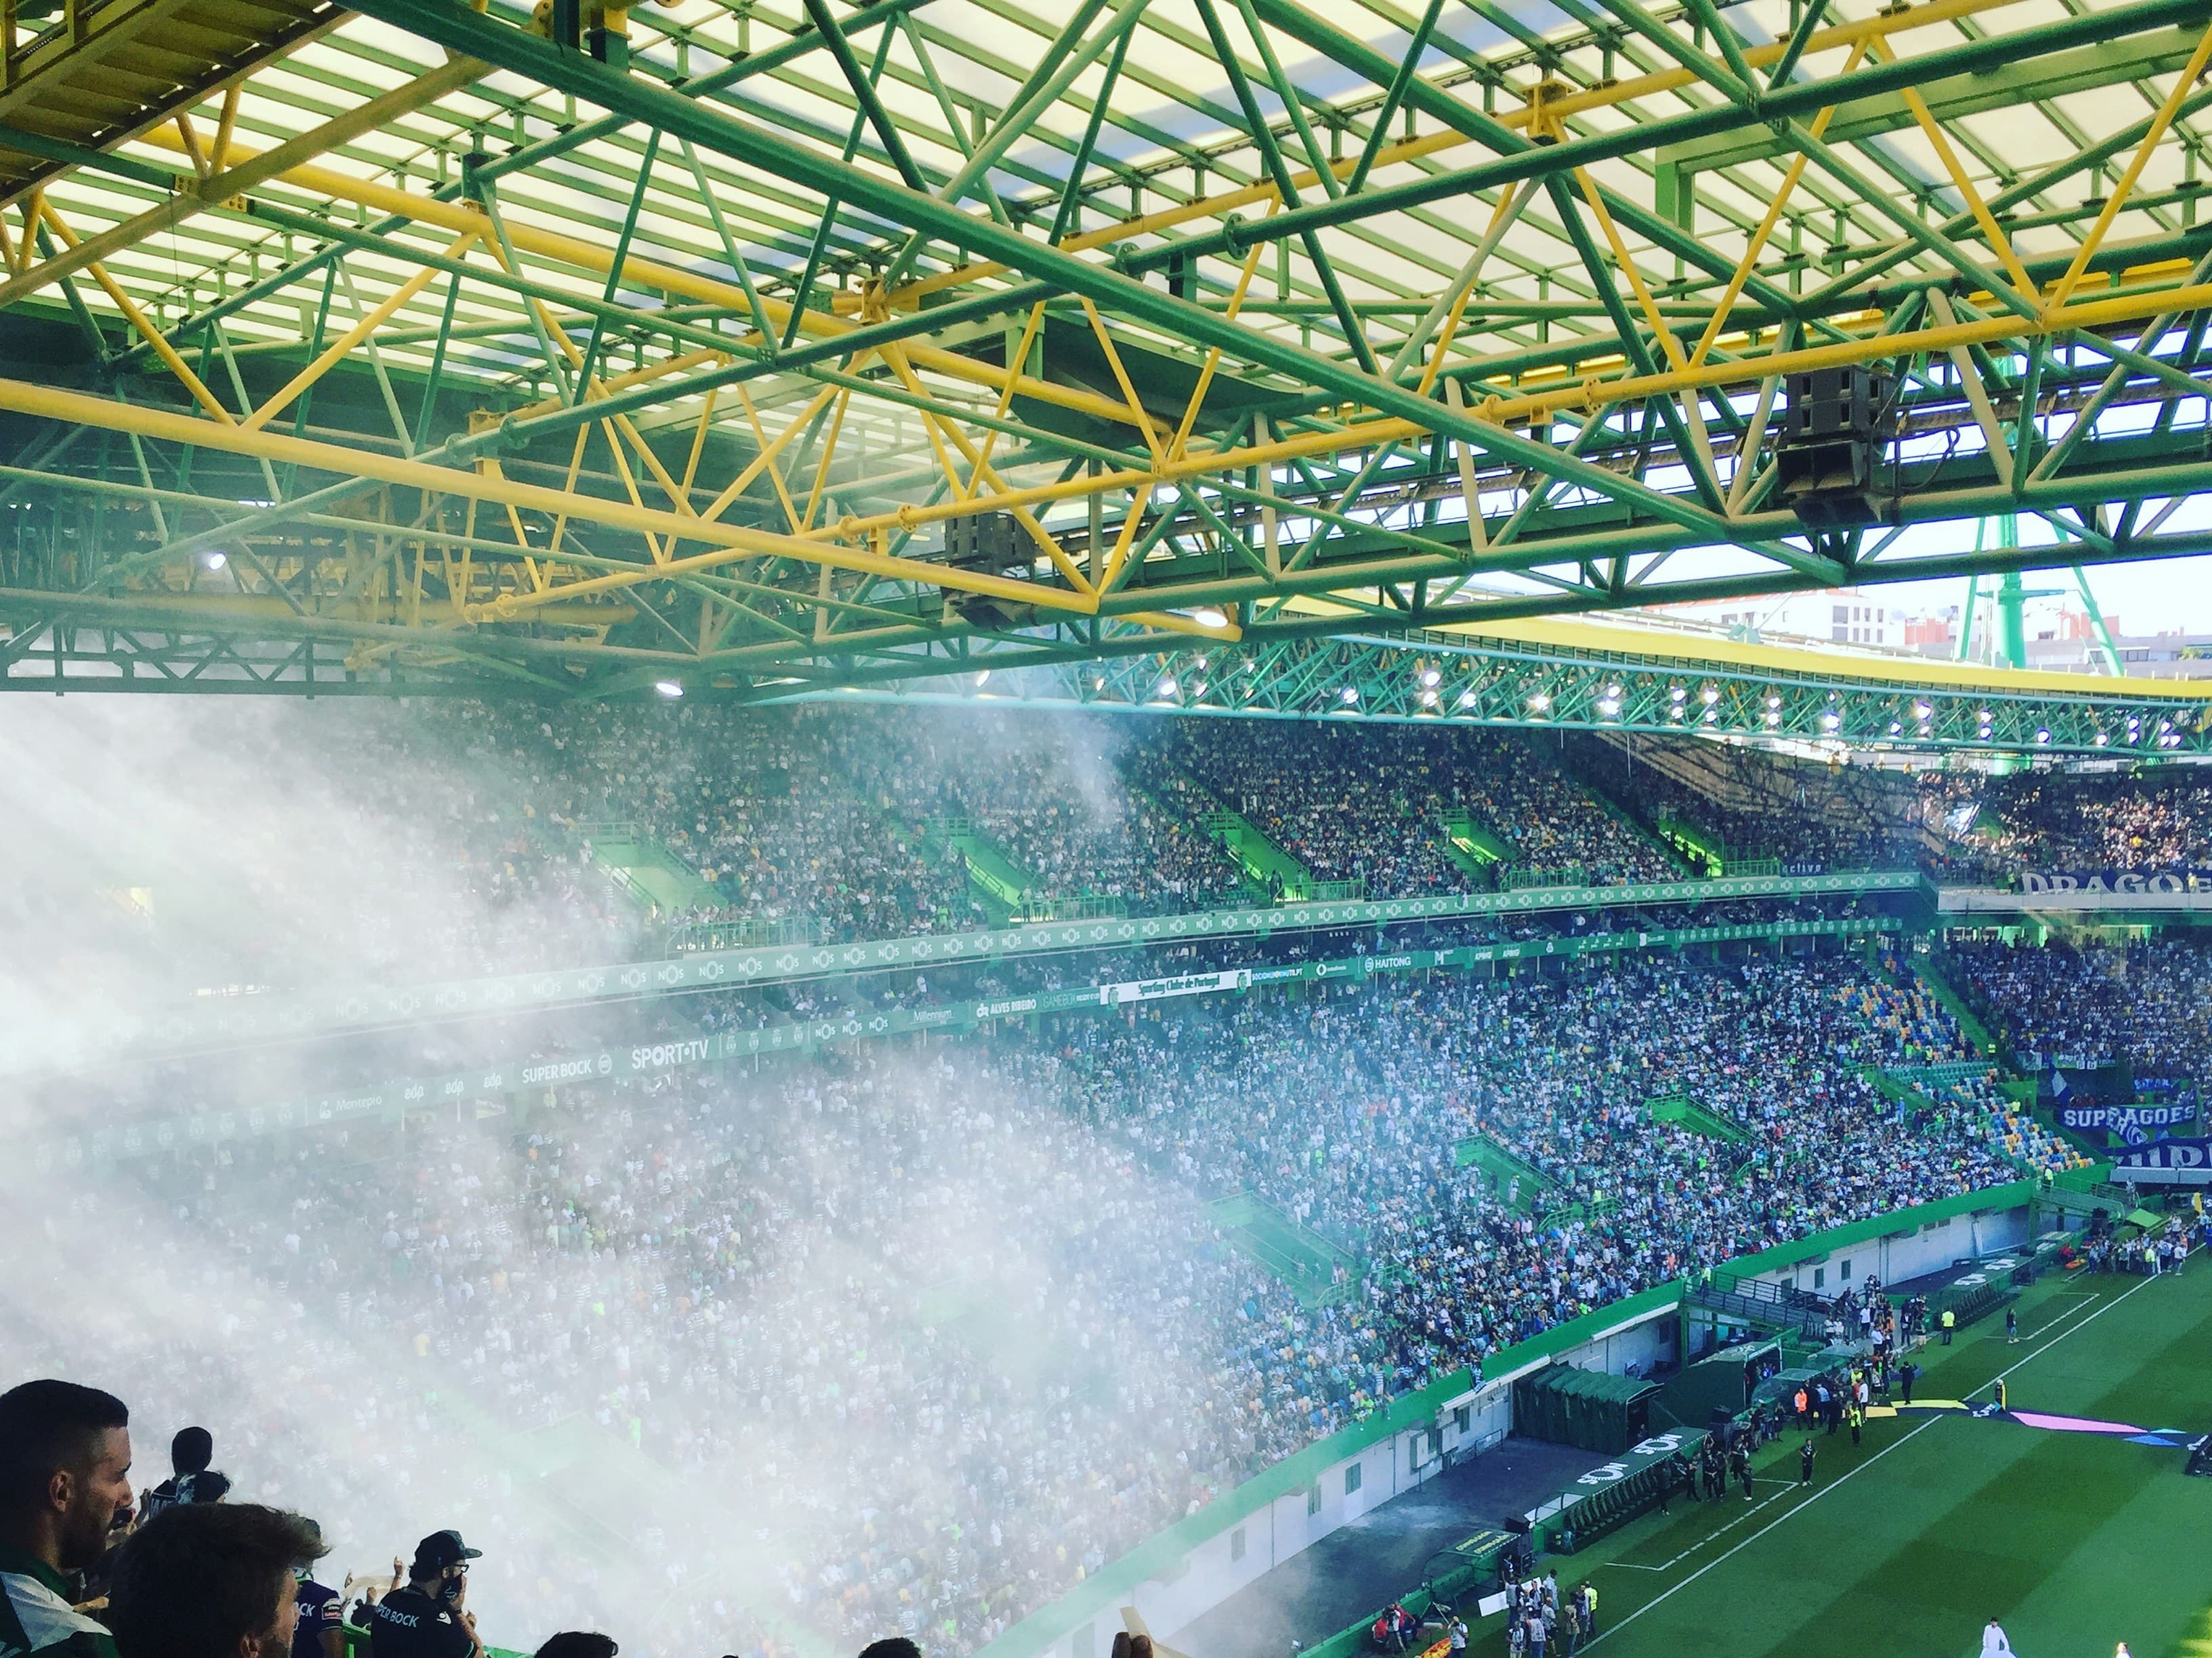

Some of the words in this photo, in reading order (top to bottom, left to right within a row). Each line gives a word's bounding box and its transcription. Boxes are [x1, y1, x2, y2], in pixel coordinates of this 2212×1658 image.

[390, 992, 421, 1014] NOS
[435, 988, 467, 1008] NOS
[485, 982, 515, 1003] NOS
[533, 977, 561, 997] NOS
[578, 973, 605, 992] NOS
[621, 968, 646, 988] NOS
[658, 965, 684, 984] NOS
[699, 961, 724, 979] NOS
[739, 957, 762, 975] NOS
[776, 954, 800, 972] NOS
[813, 950, 834, 969] NOS
[844, 947, 865, 965] NOS
[879, 943, 899, 961] NOS
[912, 940, 933, 958] NOS
[944, 938, 963, 954] NOS
[975, 935, 993, 951] NOS
[1002, 933, 1021, 949] NOS
[1032, 930, 1051, 946] NOS
[1063, 928, 1080, 943] NOS
[1090, 926, 1108, 940] NOS
[1118, 923, 1134, 938] NOS
[1143, 921, 1160, 935] NOS
[1170, 918, 1187, 933] NOS
[1197, 917, 1212, 931] NOS
[1222, 915, 1238, 929] NOS
[1375, 956, 1411, 969] HAITONG
[1139, 982, 1165, 996] Sporting
[1166, 979, 1184, 991] Clube
[1185, 979, 1193, 988] de
[1195, 974, 1221, 988] Portugal
[990, 1002, 1010, 1015] ALVES
[1011, 998, 1036, 1012] RIBEIRO
[815, 1024, 836, 1040] NOS
[843, 1019, 863, 1036] NOS
[869, 1017, 888, 1032] NOS
[523, 1064, 559, 1084] SUPER
[560, 1059, 592, 1077] BOCK
[336, 1093, 383, 1112] Montepio
[390, 1611, 419, 1628] BOCK
